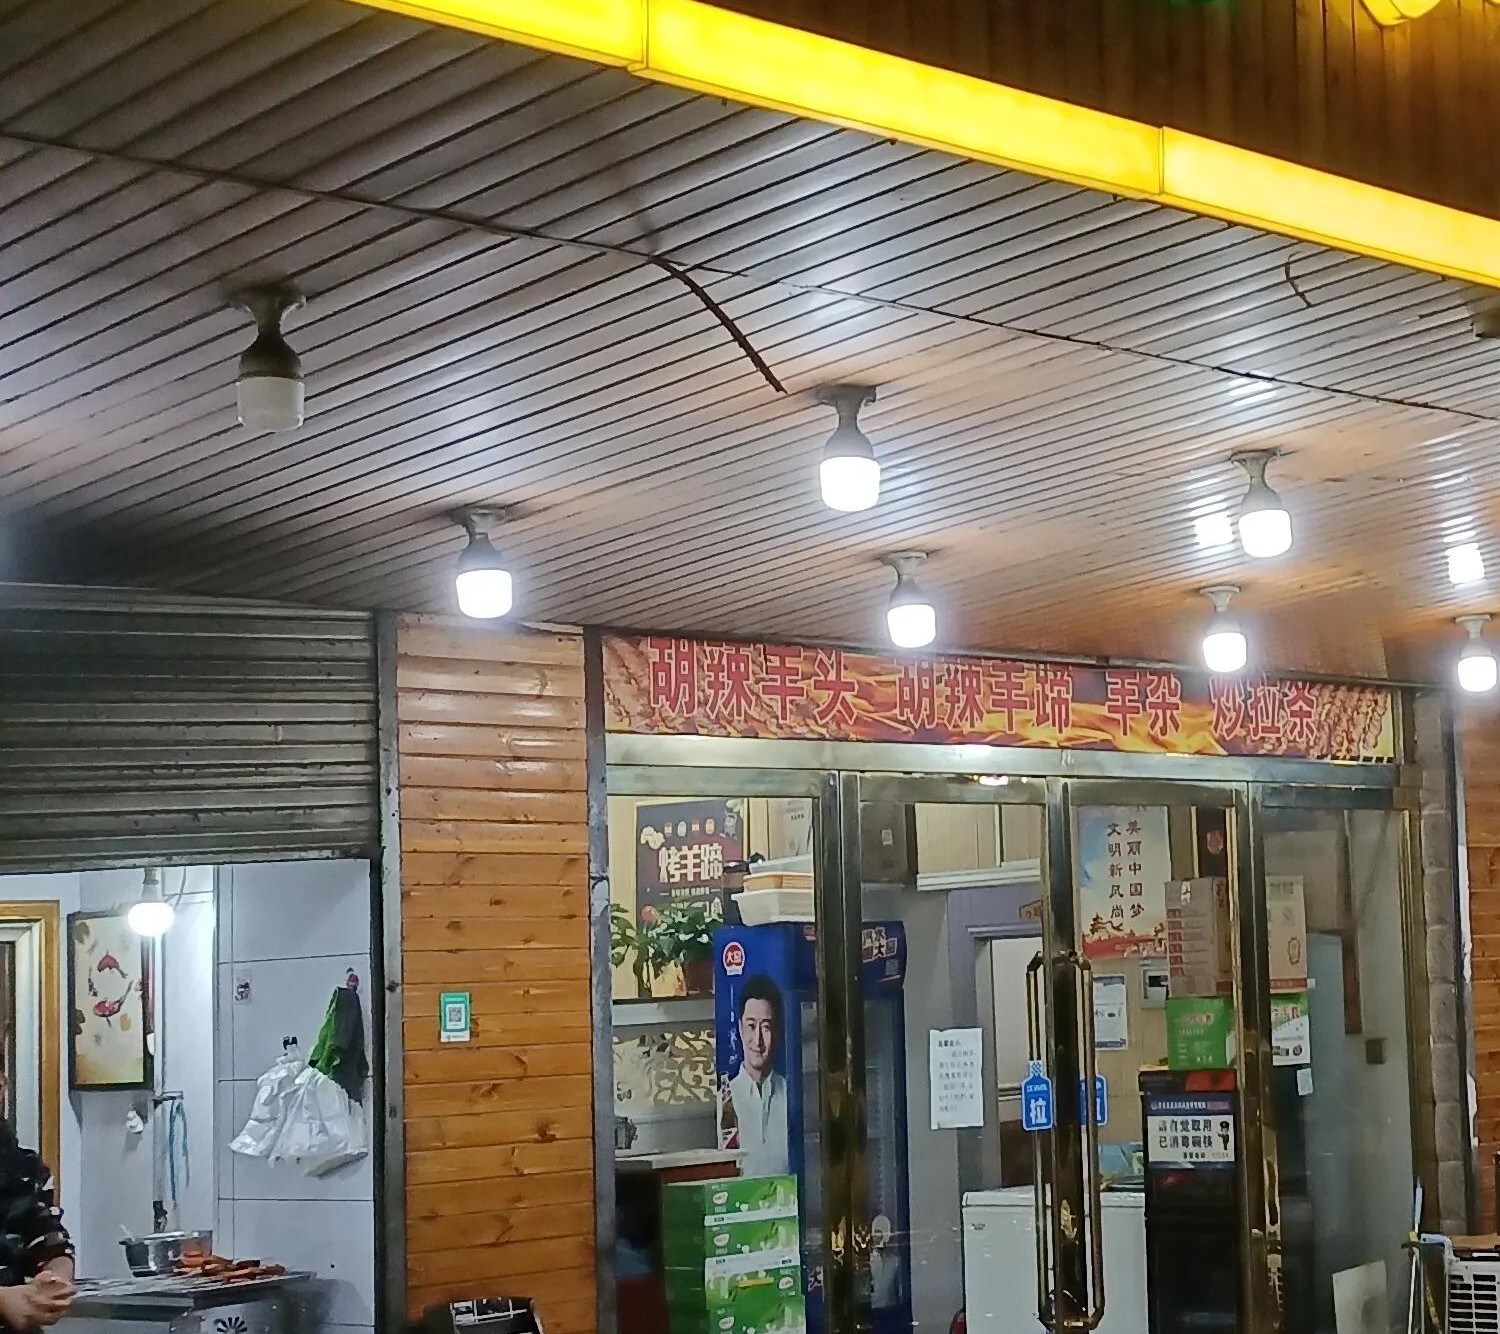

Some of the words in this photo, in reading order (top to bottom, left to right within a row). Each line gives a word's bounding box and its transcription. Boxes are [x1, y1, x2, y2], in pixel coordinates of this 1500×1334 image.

[648, 636, 858, 725] 胡辣羊头
[897, 657, 1073, 734] 胡辣羊蹄
[1104, 670, 1182, 739] 羊杂
[658, 842, 724, 884] 烤羊蹄
[1106, 822, 1125, 919] 文明新风尚
[1126, 819, 1145, 919] 美丽中国梦
[1029, 1096, 1048, 1125] 拉
